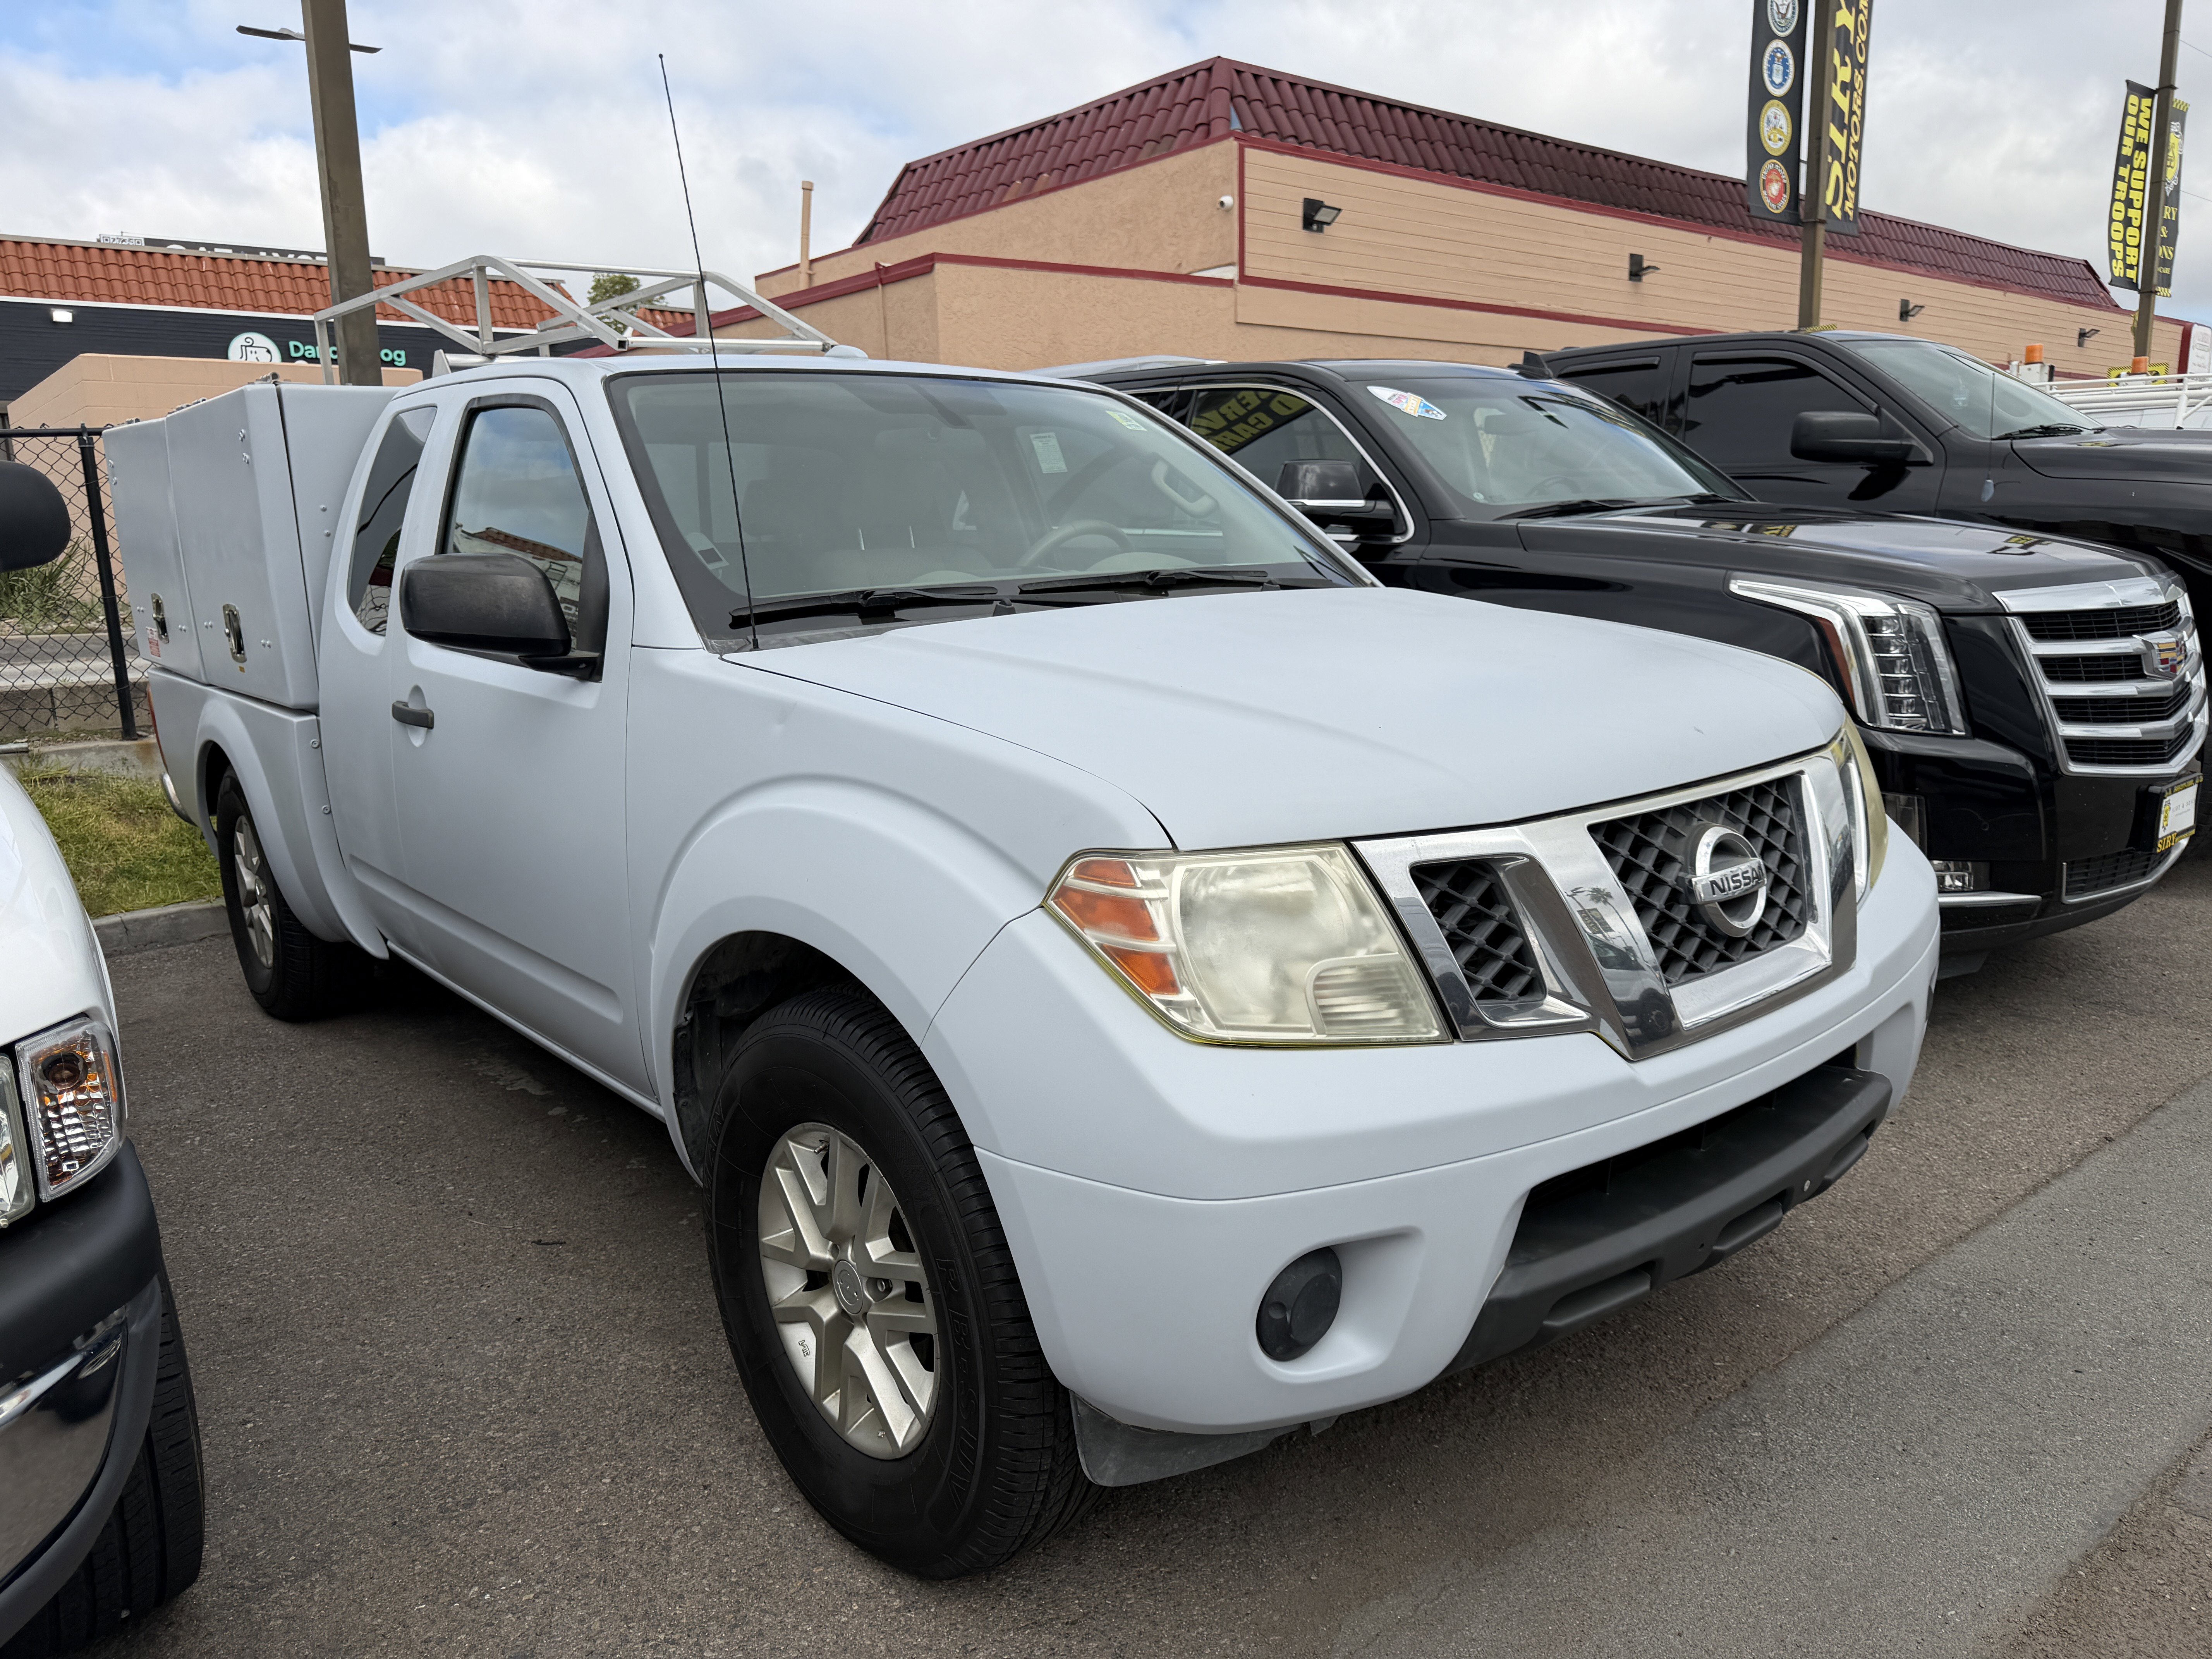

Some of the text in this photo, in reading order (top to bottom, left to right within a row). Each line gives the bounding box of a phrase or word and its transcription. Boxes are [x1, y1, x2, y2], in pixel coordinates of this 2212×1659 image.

[2111, 94, 2139, 278] OUR TROOPS
[2125, 98, 2152, 283] WE SUPPORT
[380, 349, 406, 367] og
[2157, 833, 2177, 853] SIRY
[1709, 864, 1764, 896] NISSAN
